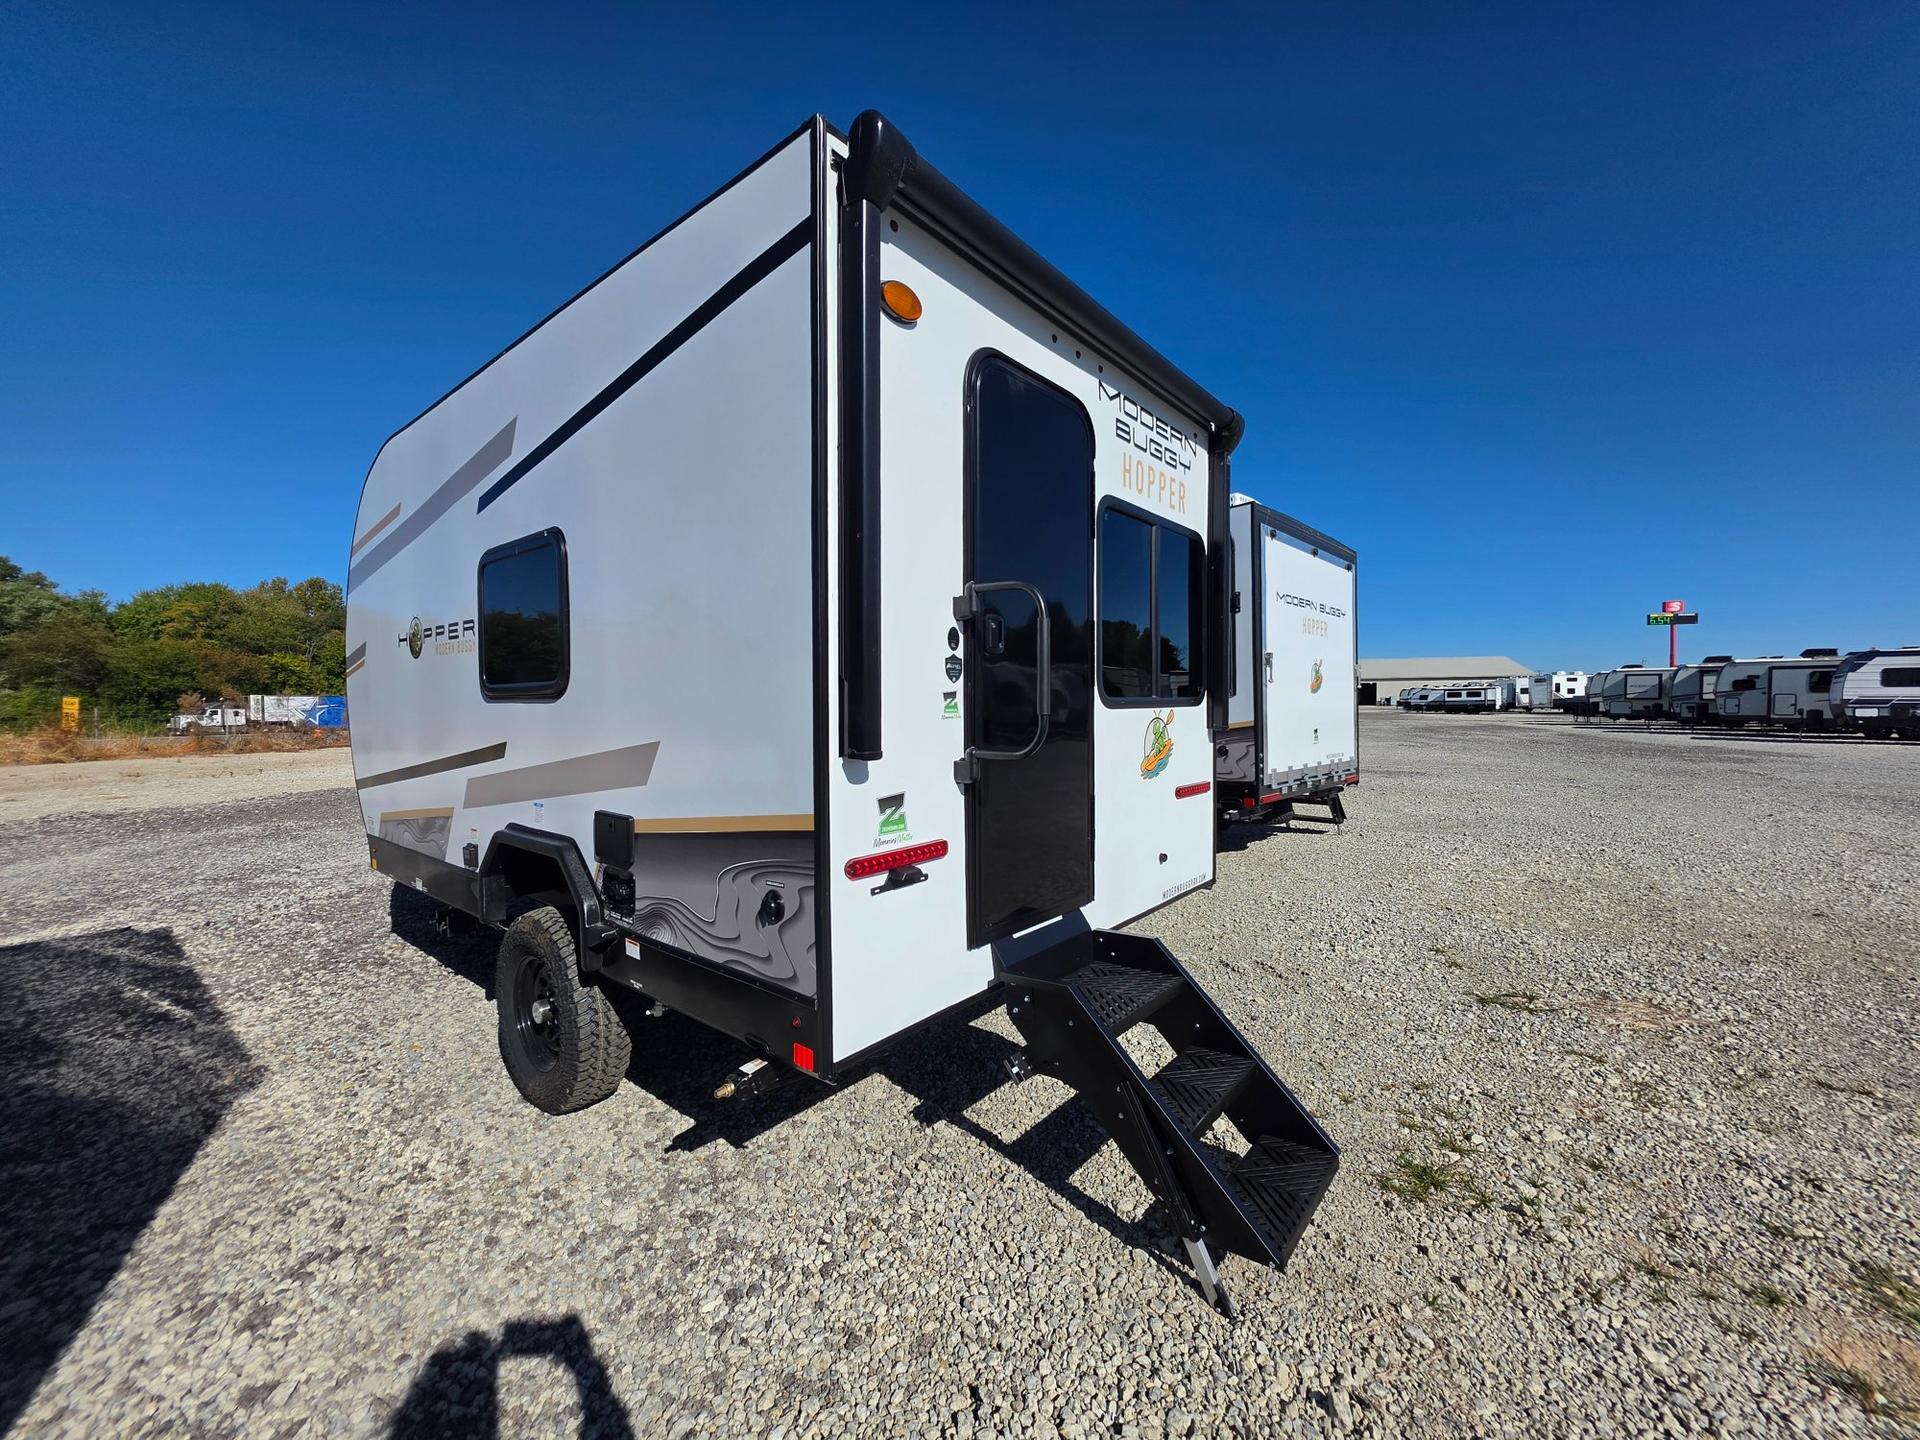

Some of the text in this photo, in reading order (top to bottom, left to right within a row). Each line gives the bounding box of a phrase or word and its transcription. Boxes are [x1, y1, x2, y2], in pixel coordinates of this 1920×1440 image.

[1098, 379, 1197, 458] MODERN
[1115, 417, 1191, 475] BUGGY
[1123, 452, 1186, 514] HOPPER
[1276, 591, 1346, 618] MODERN BUGGY
[1303, 616, 1328, 637] HOPPER
